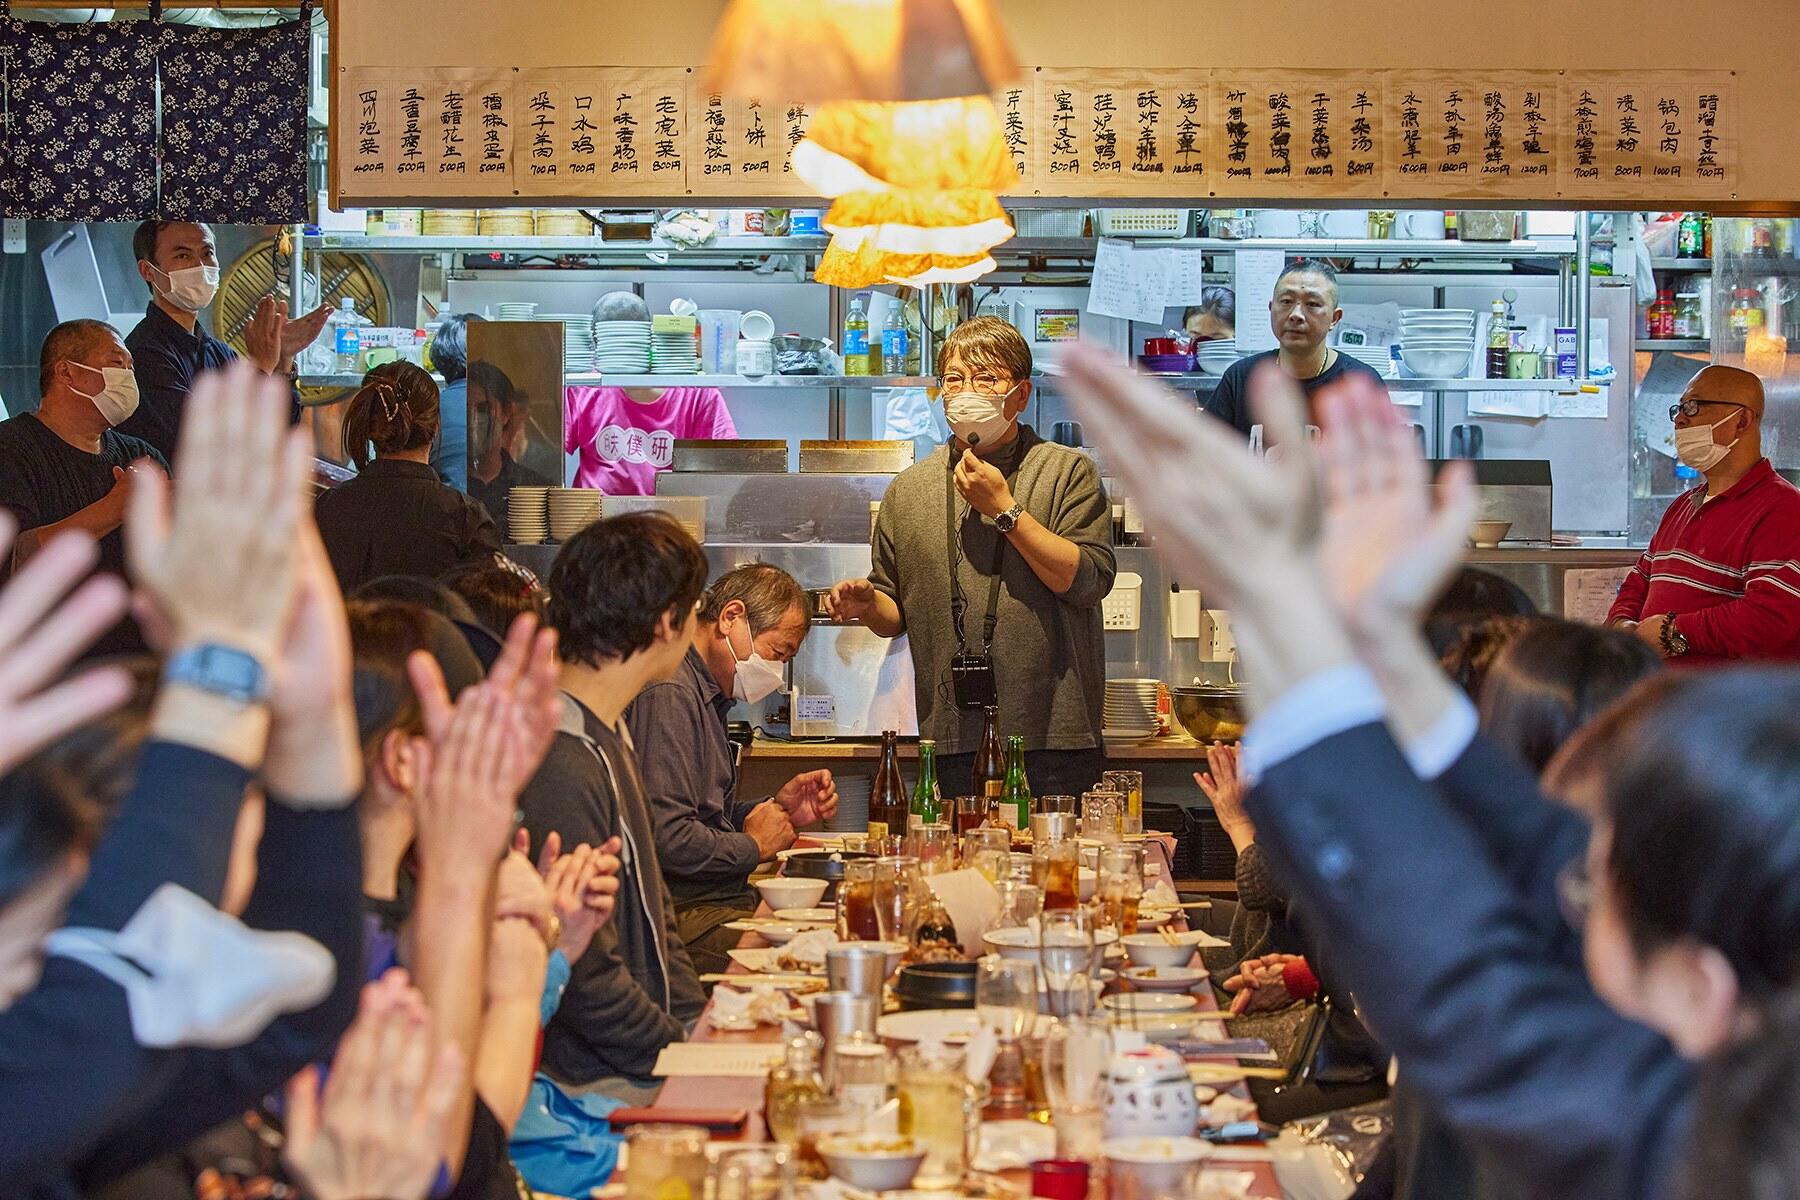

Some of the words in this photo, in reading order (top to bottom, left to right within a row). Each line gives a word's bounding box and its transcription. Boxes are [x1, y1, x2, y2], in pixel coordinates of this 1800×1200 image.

[359, 90, 380, 154] 四川泡菜
[440, 90, 464, 157] 老醋花生
[571, 96, 597, 154] 口水鸡
[655, 96, 680, 158] 老虎菜
[1402, 91, 1422, 159] 水煮肥羊
[1444, 90, 1465, 155] 手抓羊肉
[1657, 98, 1681, 154] 锅包肉
[354, 163, 384, 173] 400円
[397, 161, 425, 173] 500円
[439, 162, 465, 173] 500円
[480, 163, 505, 172] 500円
[531, 164, 556, 175] 700円
[569, 163, 595, 174] 700円
[611, 160, 638, 173] 800円
[653, 160, 680, 171] 800円
[704, 163, 731, 175] 300円
[742, 161, 769, 173] 500円
[1050, 159, 1080, 174] 800円
[1093, 160, 1121, 173] 900円
[1400, 163, 1427, 173] 1500円
[1438, 162, 1468, 173] 1800円
[1481, 164, 1510, 176] 1200円
[1521, 165, 1547, 175] 1200円
[1615, 165, 1642, 177] 800円
[1654, 166, 1681, 177] 1000円
[1574, 168, 1598, 179] 700円
[1697, 168, 1724, 180] 700円
